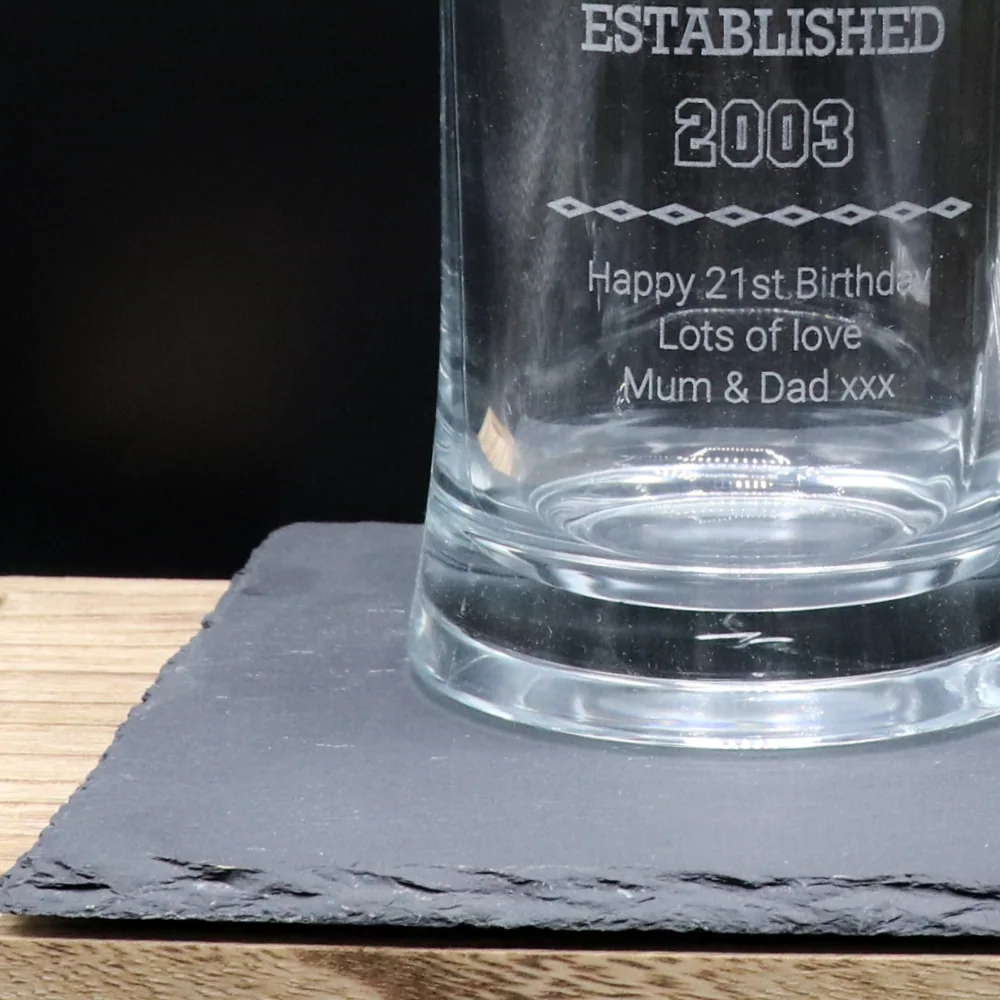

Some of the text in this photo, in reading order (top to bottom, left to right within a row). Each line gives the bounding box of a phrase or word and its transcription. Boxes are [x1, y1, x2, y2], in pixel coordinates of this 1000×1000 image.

[580, 3, 945, 57] ESTABLISHED
[674, 97, 854, 168] 2003
[587, 260, 932, 307] Happy 21st Birthday
[659, 317, 862, 352] Lots of love
[623, 366, 895, 404] Mum & Dad xxx
